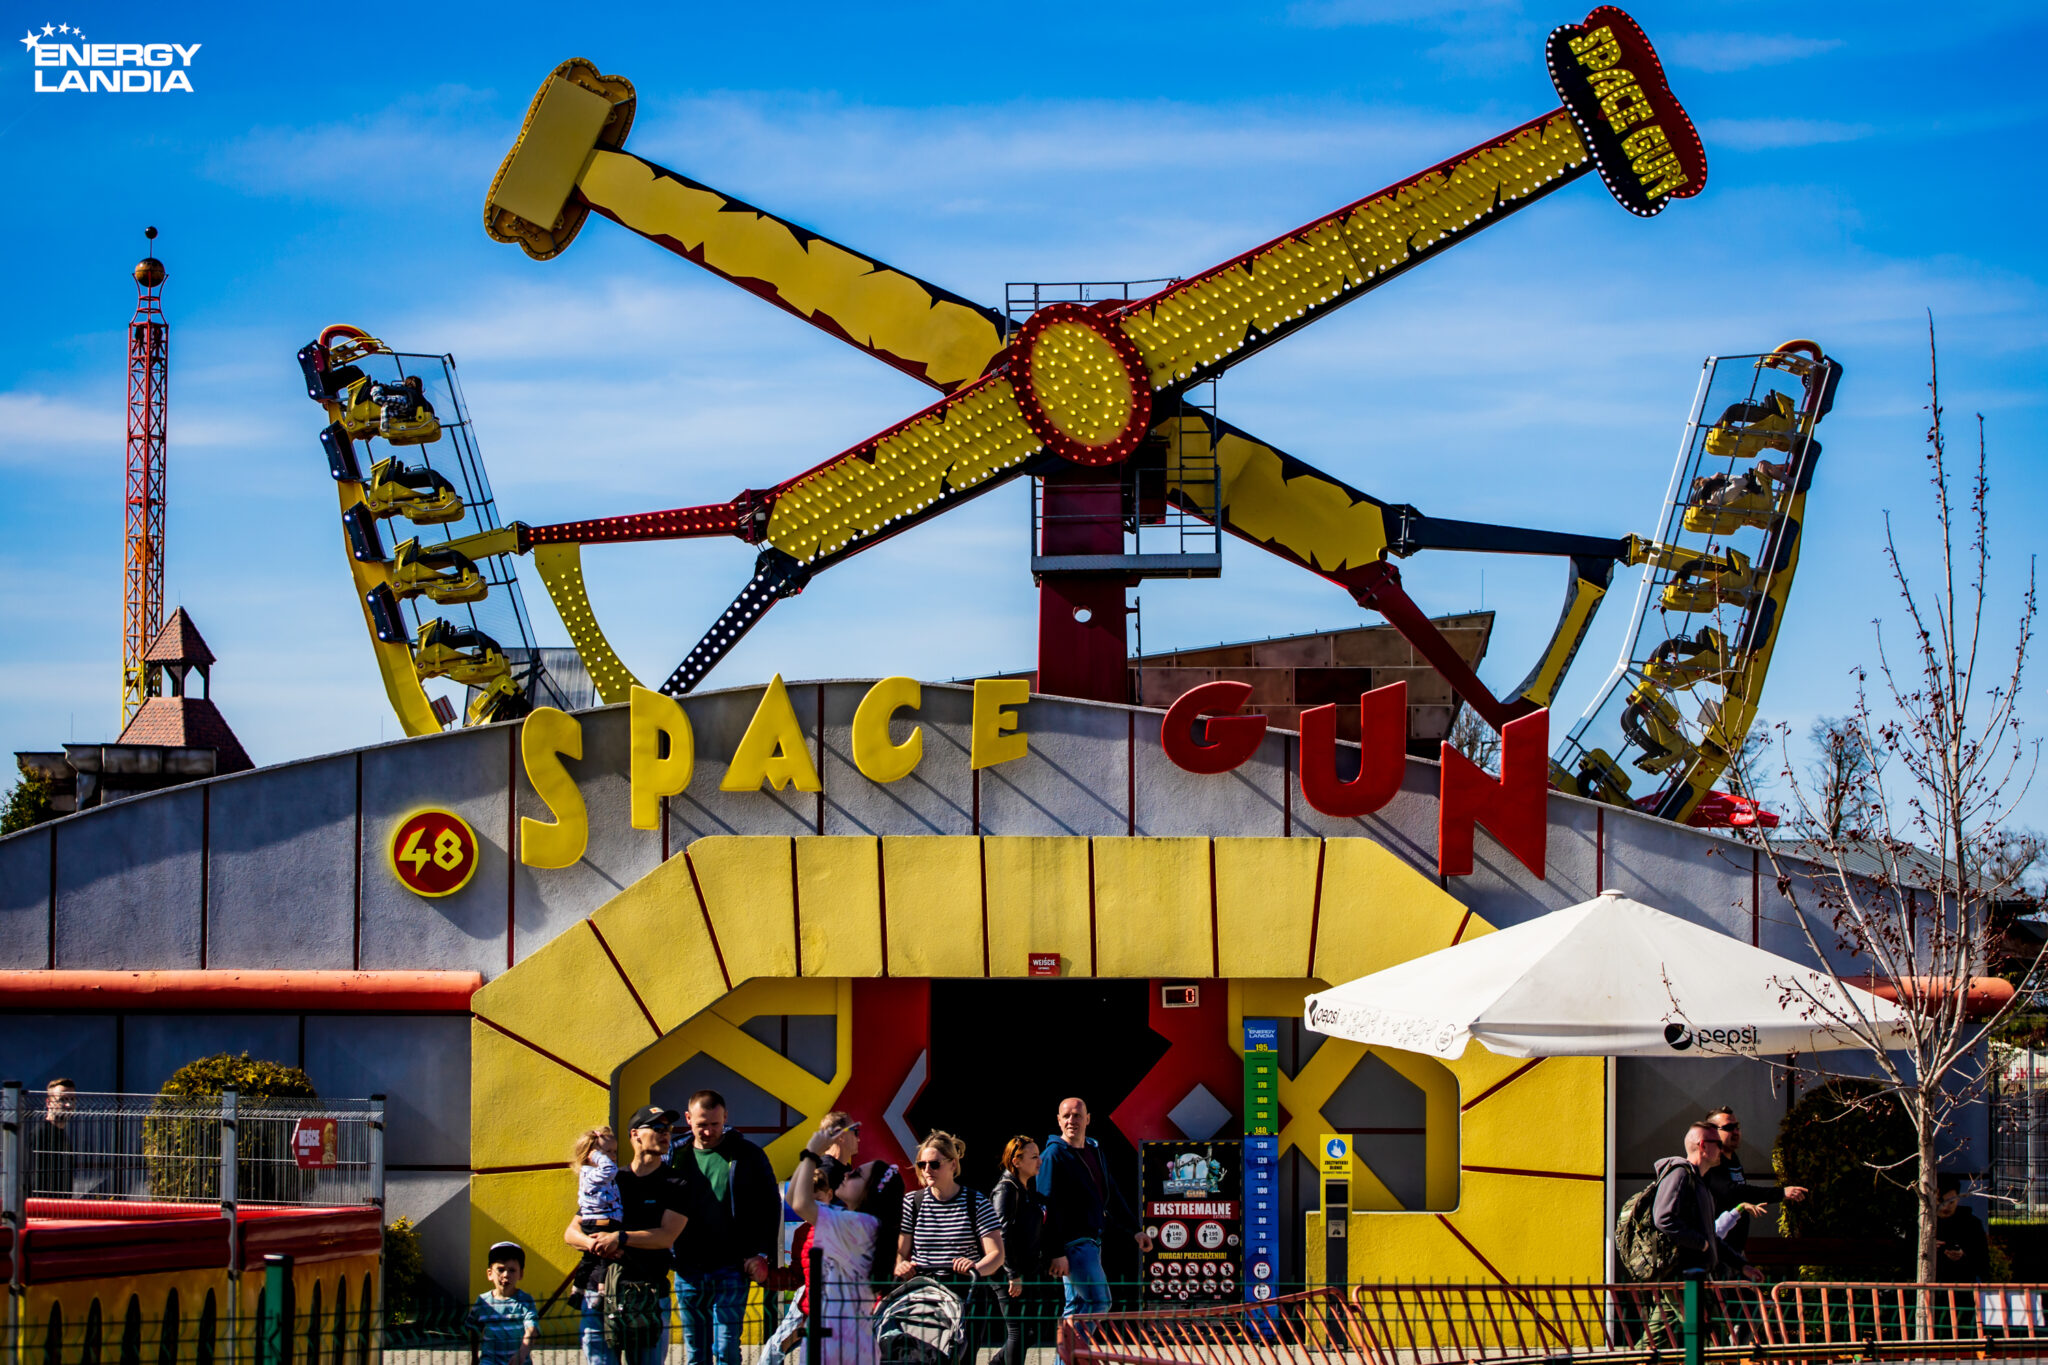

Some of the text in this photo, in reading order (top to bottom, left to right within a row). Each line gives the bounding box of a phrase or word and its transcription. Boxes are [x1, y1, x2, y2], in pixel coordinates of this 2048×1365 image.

[1567, 25, 1689, 200] SPACE GUN
[521, 673, 1549, 881] SPACE GUN
[399, 827, 464, 876] 48
[1033, 957, 1056, 966] WEJŚCIE
[1185, 988, 1195, 1003] 0
[1316, 1009, 1341, 1027] pepsi
[1698, 1026, 1758, 1048] pepsi
[1256, 1043, 1268, 1052] 195
[1257, 1081, 1267, 1089] 170
[1255, 1126, 1267, 1134] 140
[1153, 1202, 1231, 1216] EKSTREMALNE
[1158, 1252, 1183, 1260] UWAGA!
